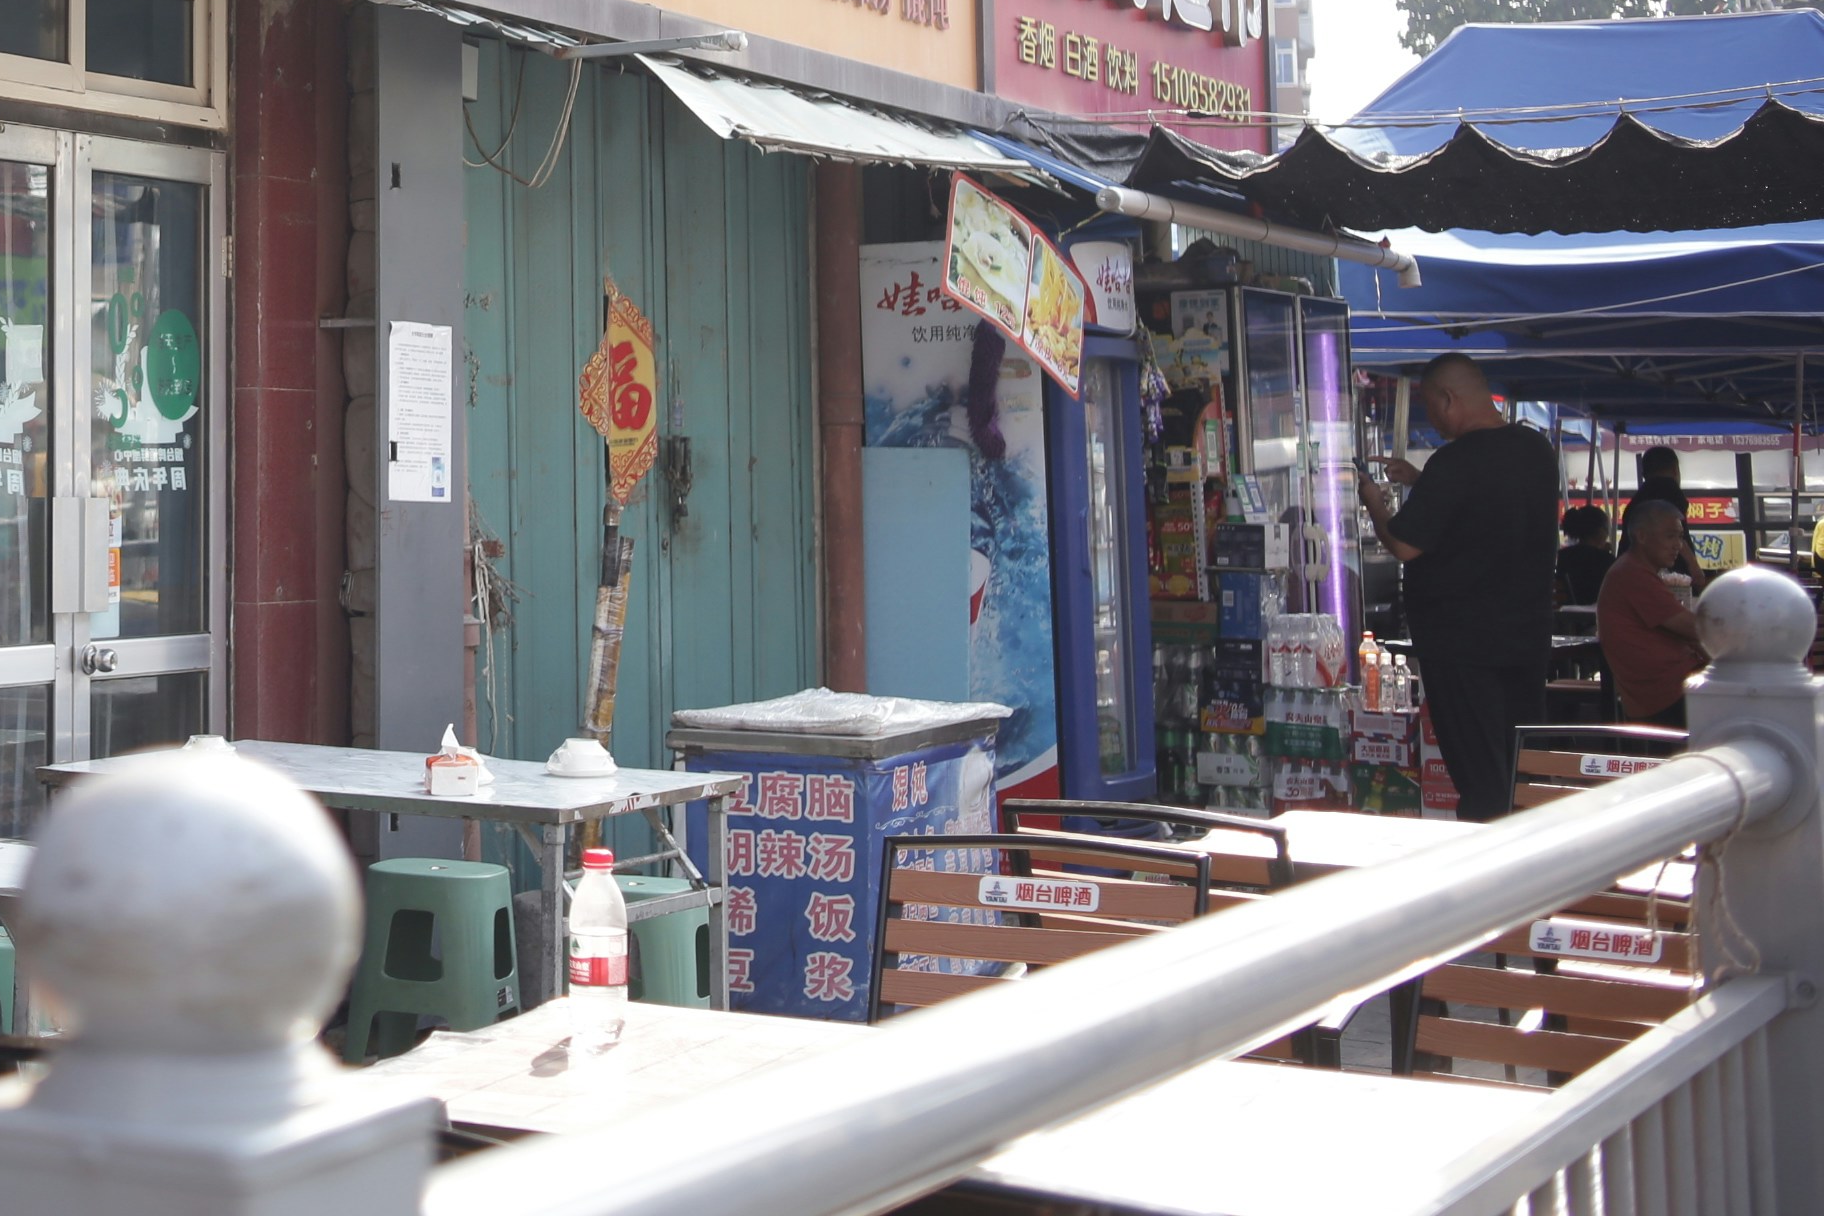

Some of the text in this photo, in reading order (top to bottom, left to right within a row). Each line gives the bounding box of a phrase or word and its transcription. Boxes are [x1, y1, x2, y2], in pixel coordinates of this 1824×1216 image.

[1018, 15, 1140, 96] 香烟 白酒 饮料
[1152, 60, 1252, 124] 15106582931
[891, 760, 928, 812] 馄饨
[984, 895, 1008, 904] YANTAI
[1015, 883, 1092, 907] 烟台啤酒
[1569, 929, 1655, 957] 烟台啤酒
